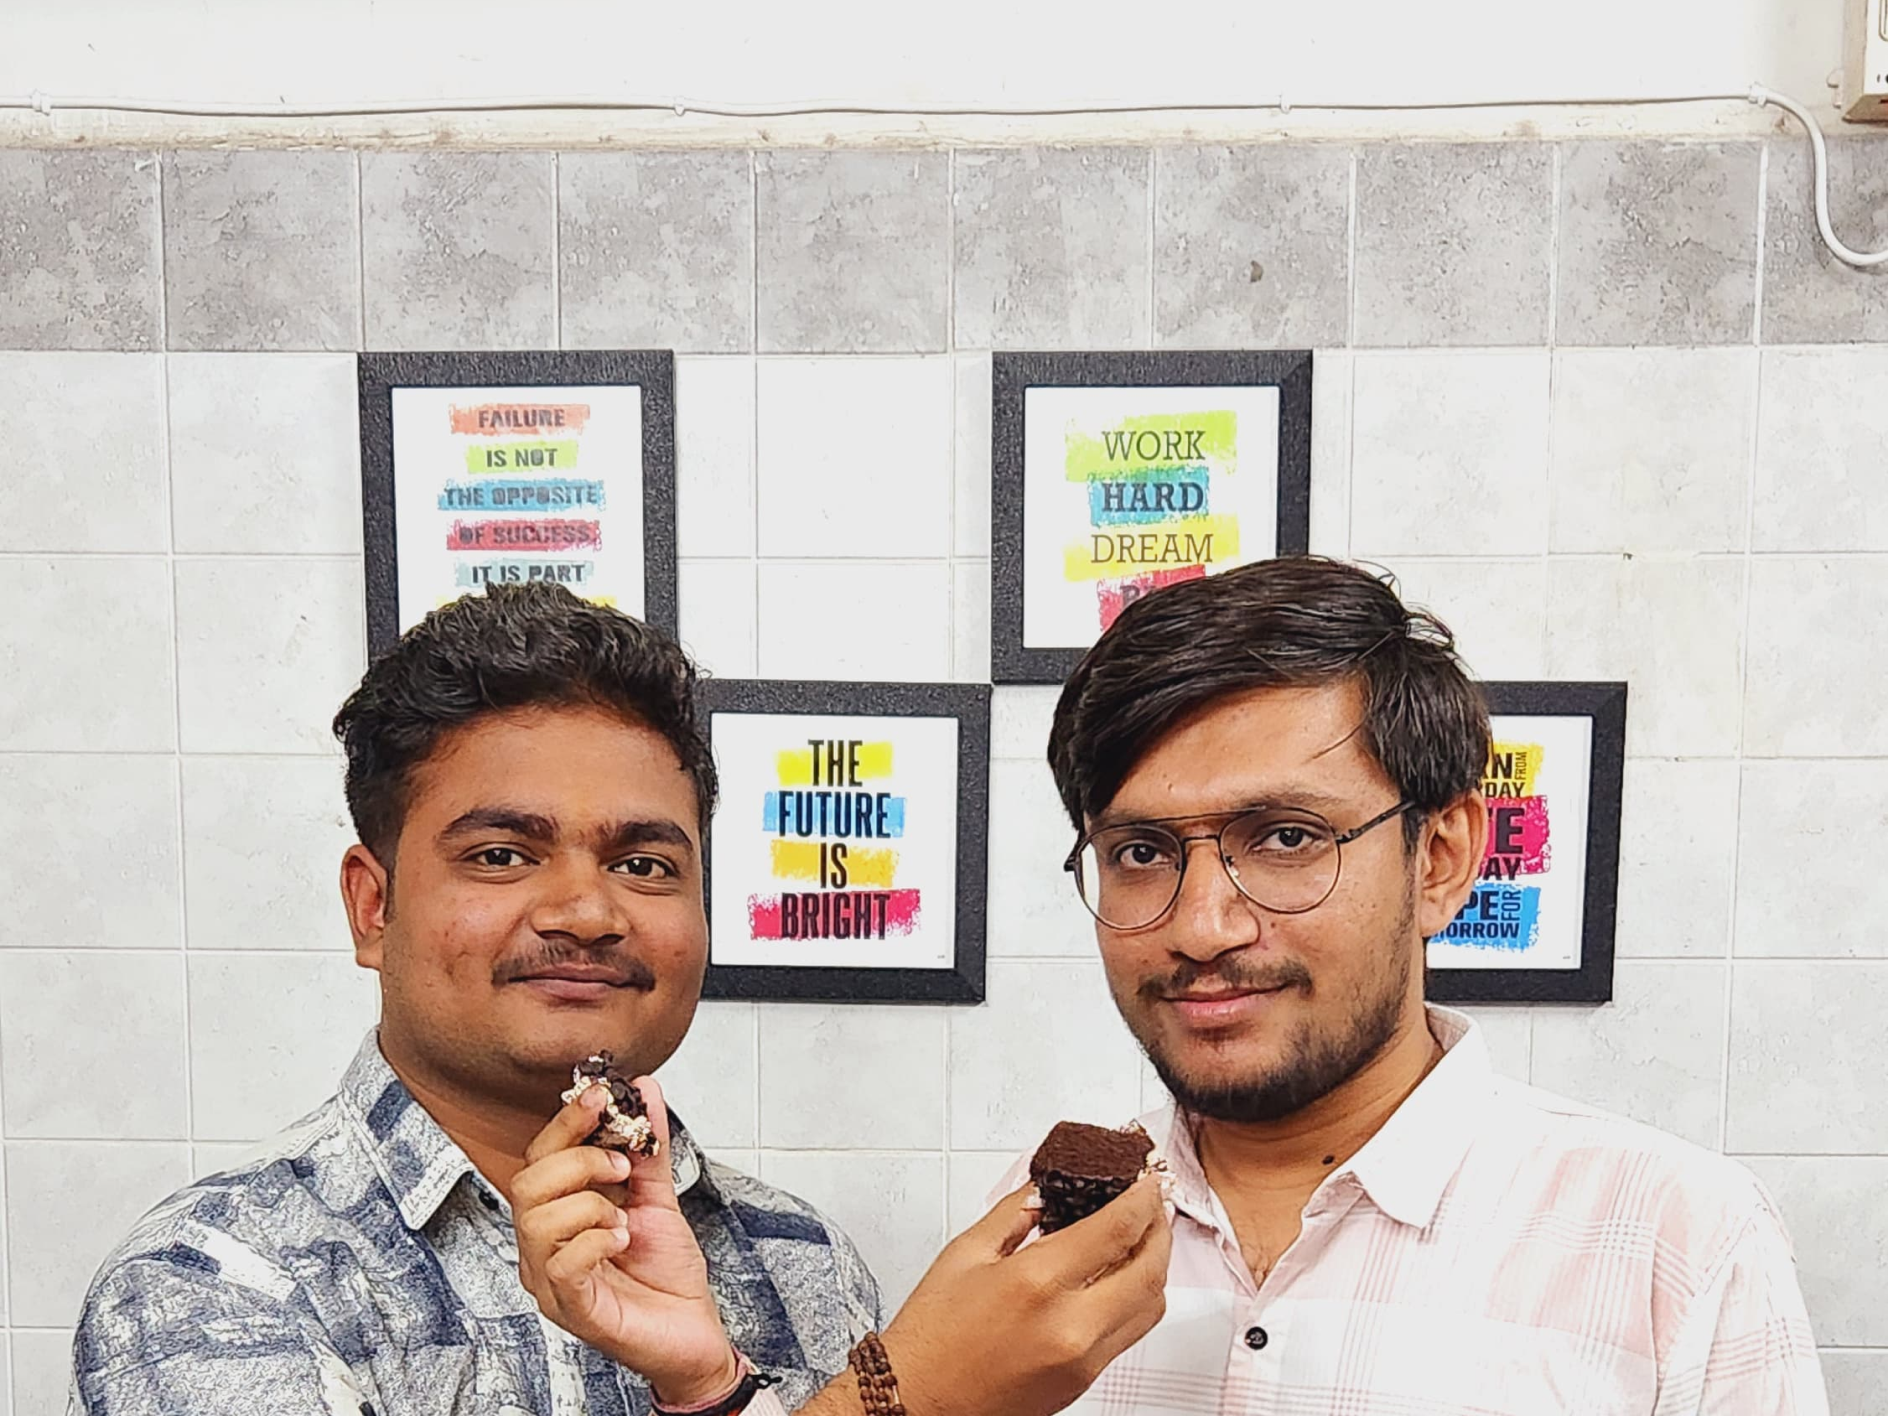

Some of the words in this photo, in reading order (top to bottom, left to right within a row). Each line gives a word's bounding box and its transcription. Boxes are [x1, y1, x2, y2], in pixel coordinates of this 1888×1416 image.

[478, 408, 566, 428] FAILURE
[486, 449, 508, 467] IS
[515, 448, 558, 467] NOT
[1101, 430, 1206, 461] WORK
[444, 487, 485, 506] THE
[492, 485, 598, 505] OPPOSITE
[1101, 481, 1204, 512] HARD
[459, 526, 485, 544] OF
[1090, 533, 1214, 563] DREAM
[472, 565, 492, 583] IT
[500, 565, 521, 582] IS
[528, 564, 586, 583] PART
[807, 738, 863, 787] THE
[1483, 753, 1513, 779] N
[1514, 751, 1527, 780] FROM
[1482, 782, 1525, 799] DAY
[778, 790, 891, 838] FUTURE
[819, 842, 848, 889] IS
[1478, 857, 1521, 881] AY
[780, 892, 891, 940] BRIGHT
[1500, 890, 1521, 921] FOR
